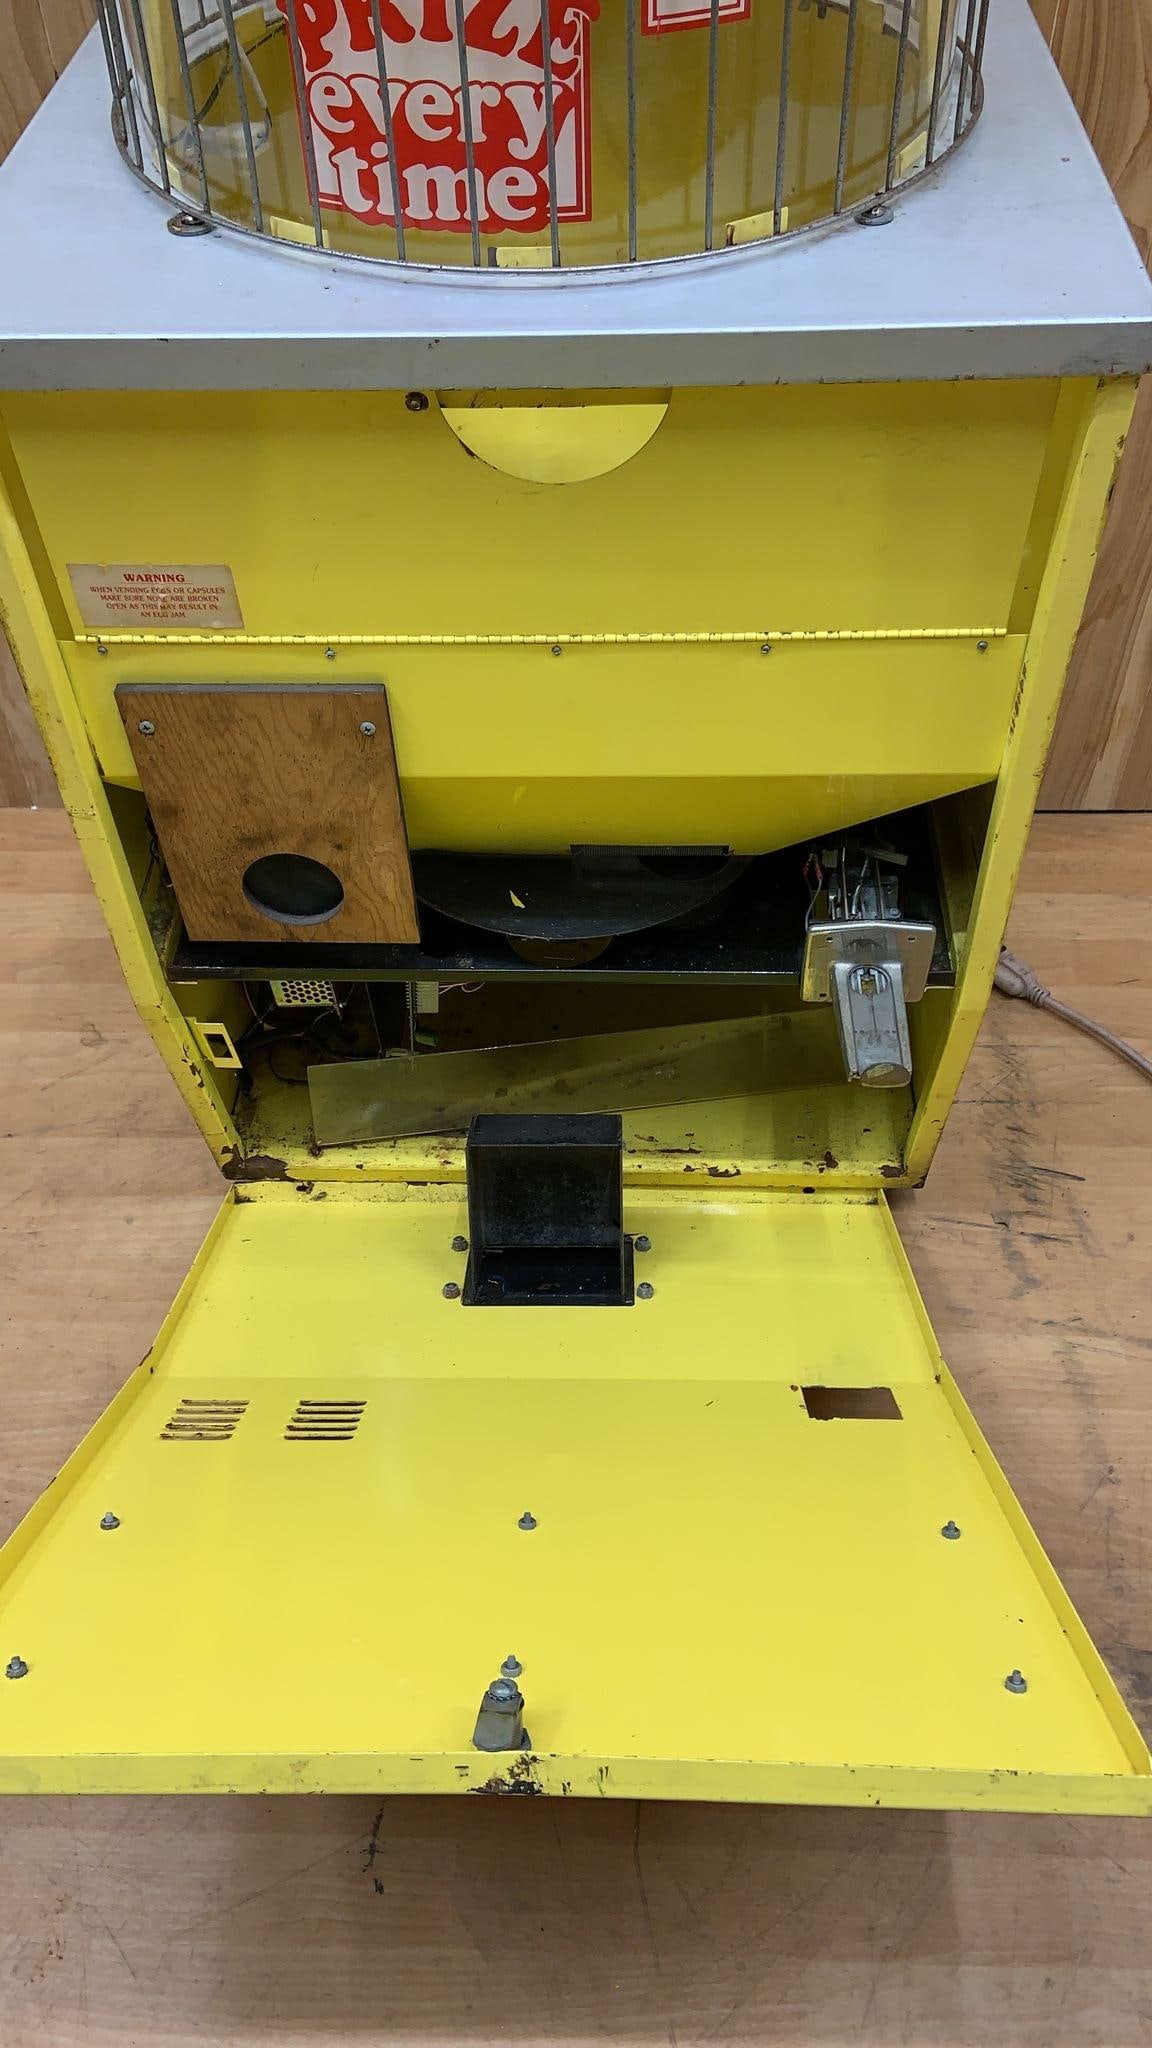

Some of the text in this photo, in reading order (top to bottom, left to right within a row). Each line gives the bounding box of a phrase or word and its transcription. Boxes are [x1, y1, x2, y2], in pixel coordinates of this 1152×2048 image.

[309, 72, 563, 160] every
[331, 142, 538, 221] time
[123, 573, 185, 583] WARNING
